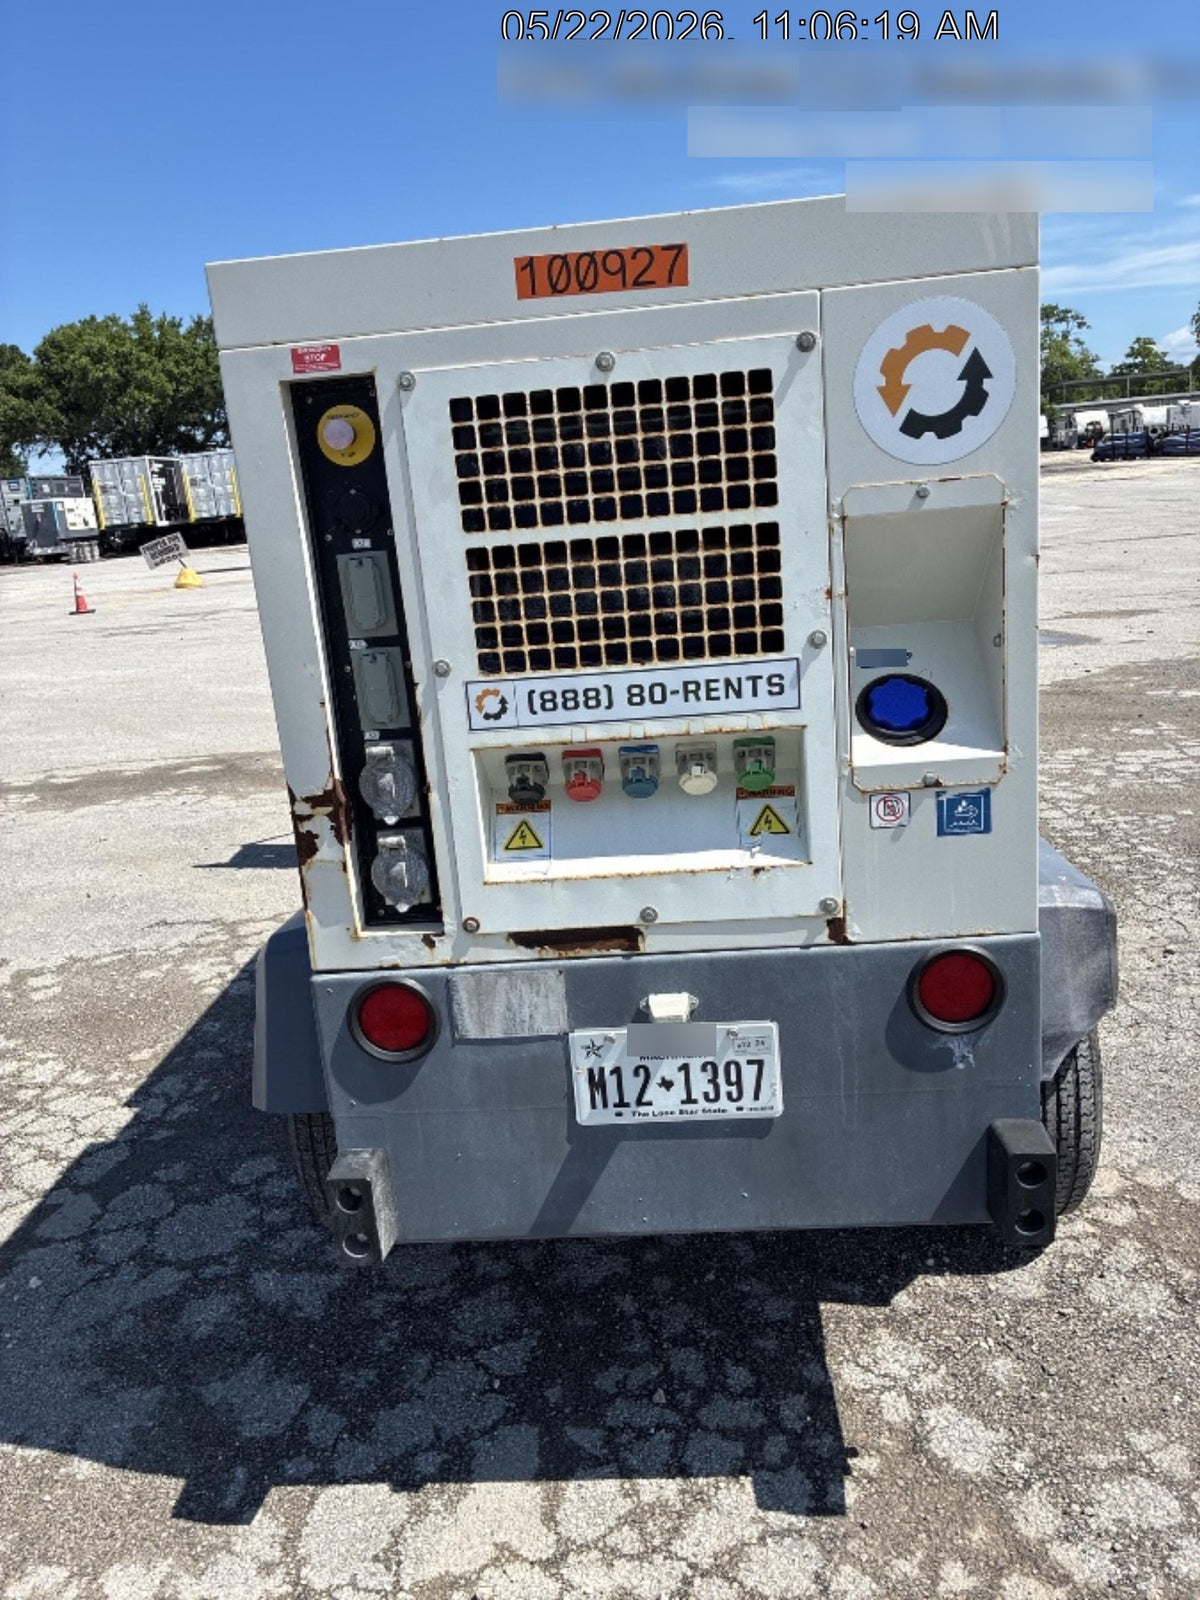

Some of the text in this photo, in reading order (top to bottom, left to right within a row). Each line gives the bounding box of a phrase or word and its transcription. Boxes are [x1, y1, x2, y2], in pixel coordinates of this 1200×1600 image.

[520, 243, 684, 297] 100927
[303, 353, 326, 363] STOP
[527, 673, 786, 716] (888) 80-RENTS
[587, 1058, 765, 1110] M12 1397
[631, 1110, 650, 1118] The
[678, 1108, 699, 1116] Star
